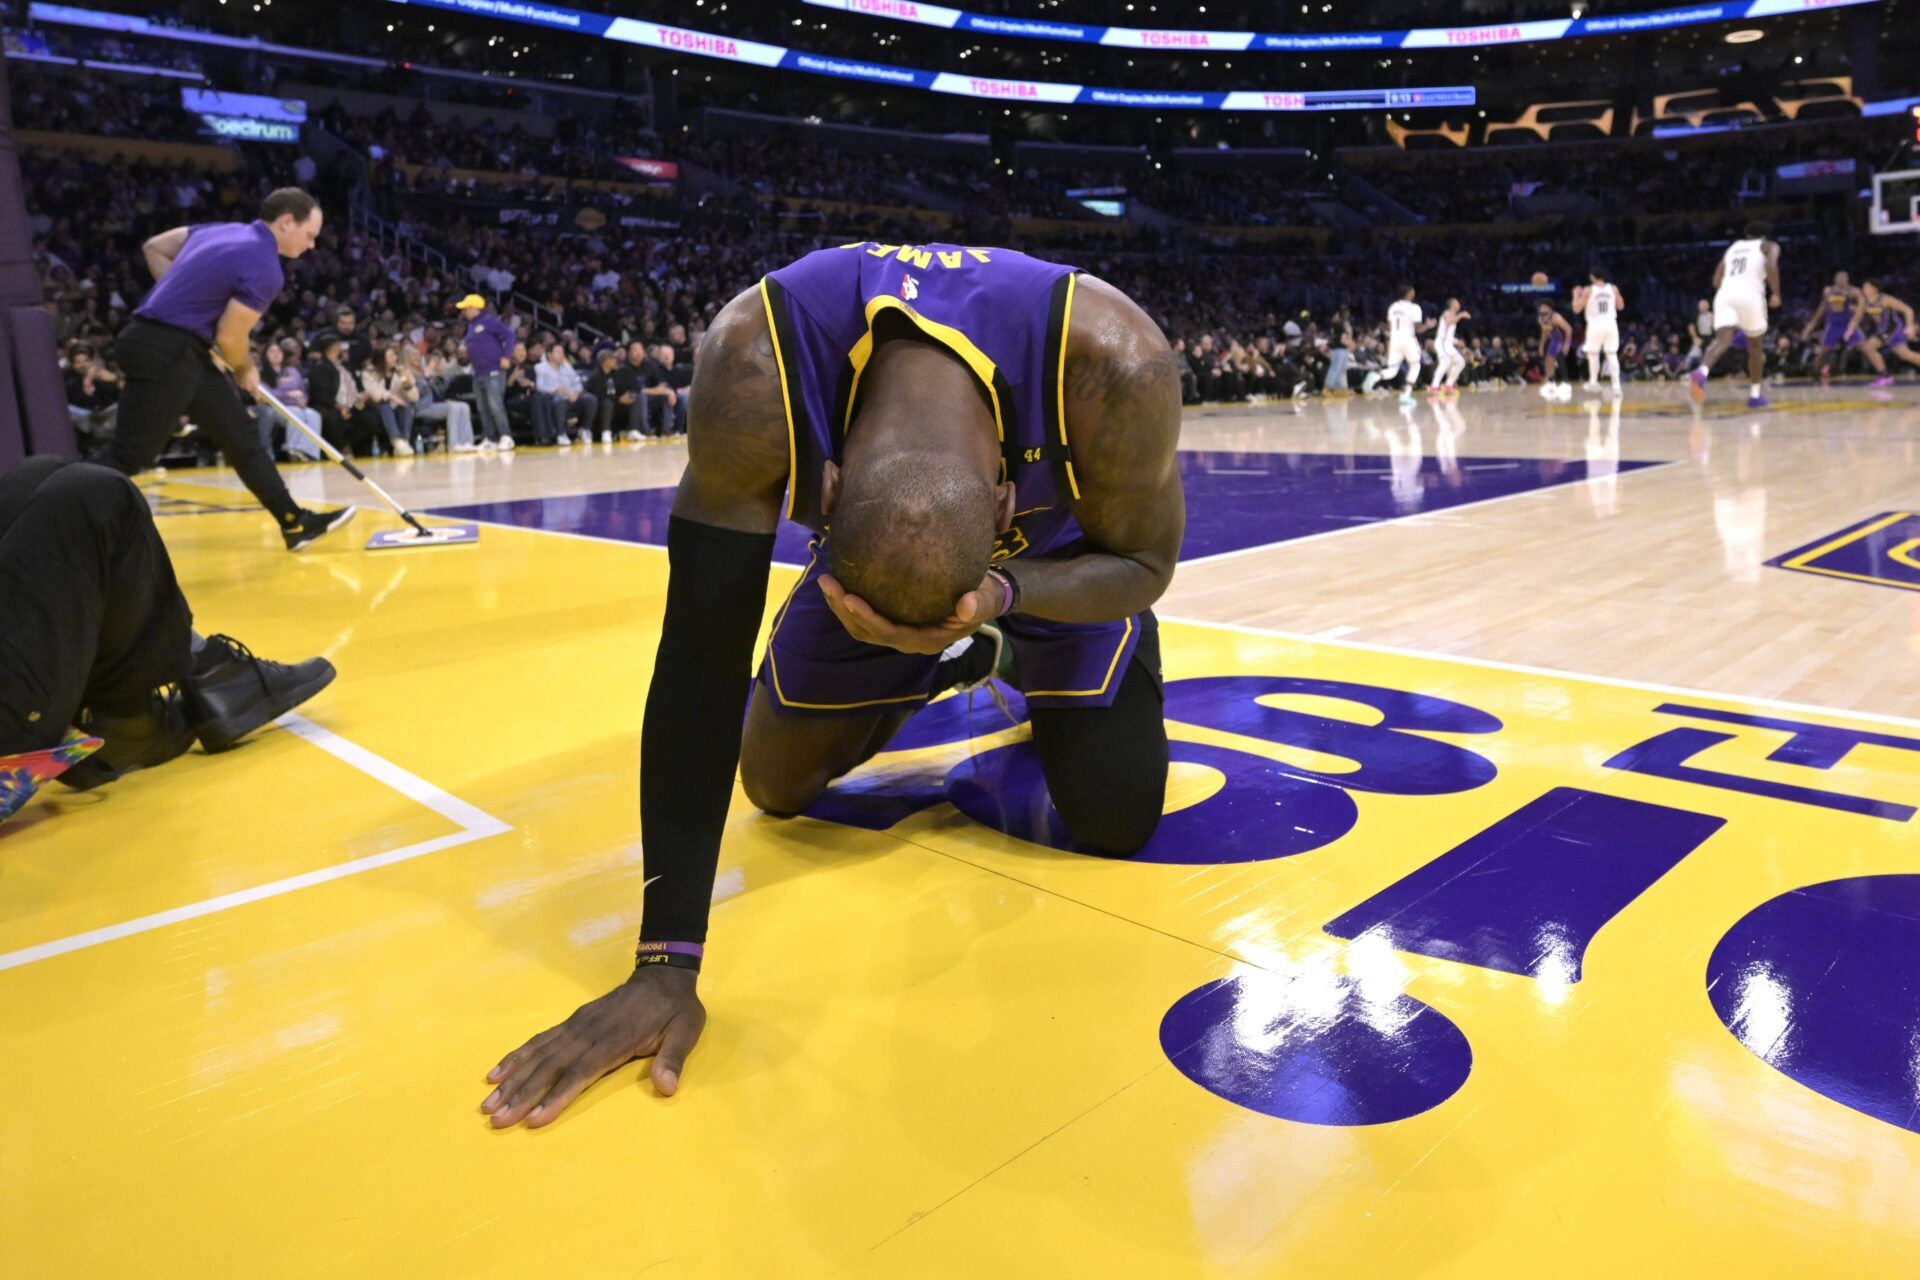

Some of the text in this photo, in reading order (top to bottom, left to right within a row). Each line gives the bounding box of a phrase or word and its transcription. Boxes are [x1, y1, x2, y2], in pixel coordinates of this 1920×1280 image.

[656, 27, 738, 56] TOSHIBA
[1140, 31, 1210, 47] TOSHIBA
[1445, 25, 1521, 44] TOSHIBA
[970, 79, 1038, 97] TOSHIBA
[839, 241, 992, 270] JAME
[1730, 256, 1747, 277] 20
[1598, 301, 1608, 314] 10
[1023, 447, 1041, 462] 44
